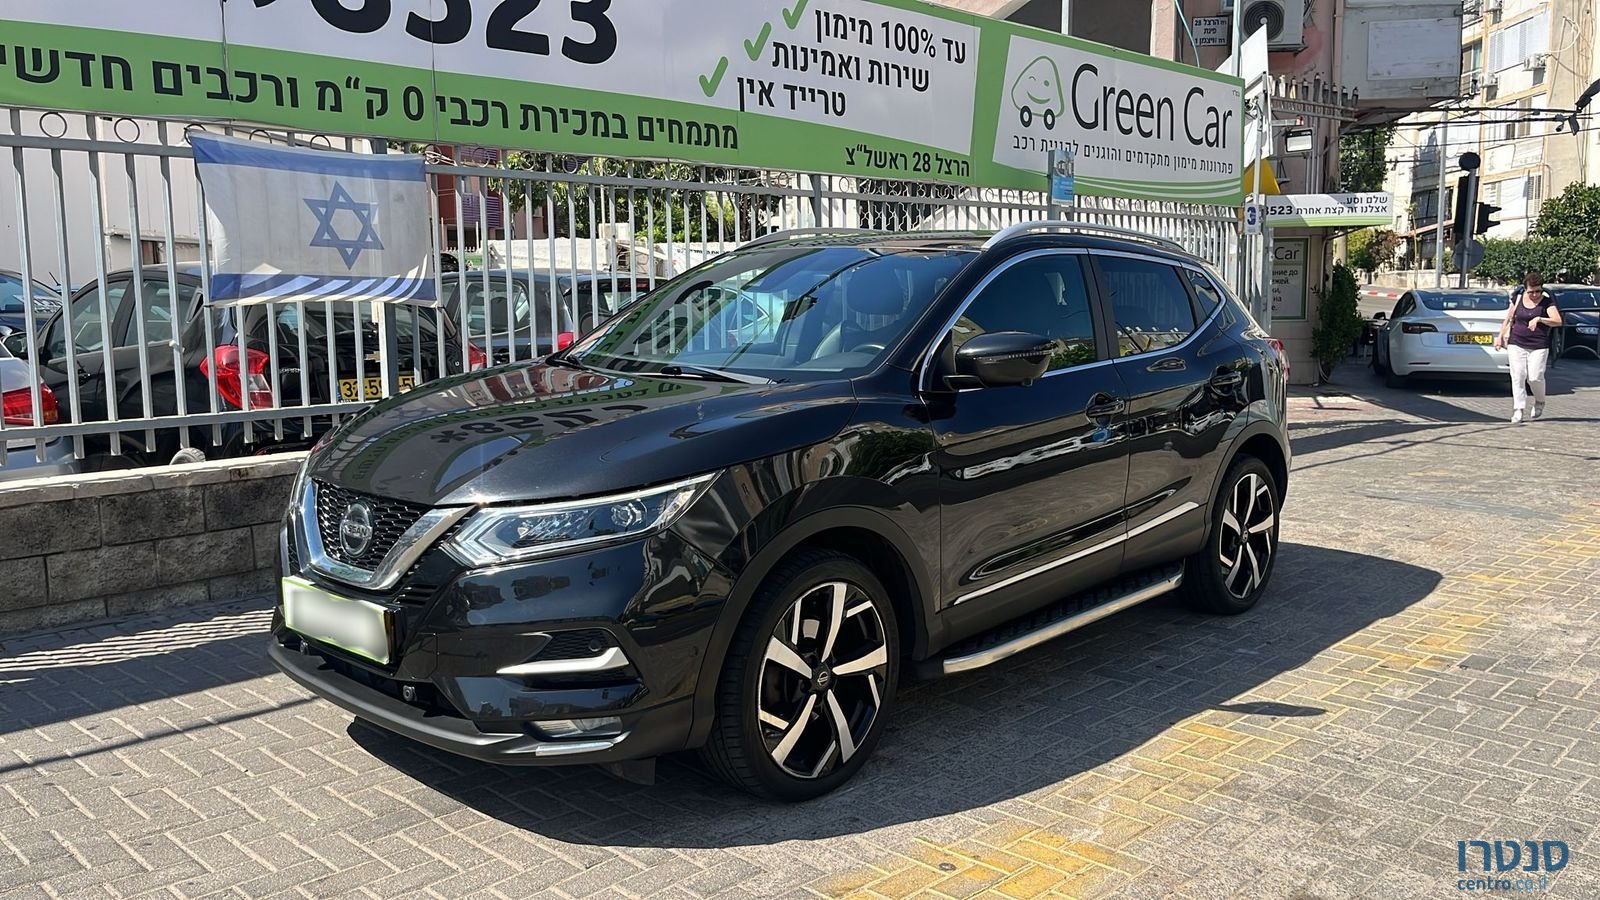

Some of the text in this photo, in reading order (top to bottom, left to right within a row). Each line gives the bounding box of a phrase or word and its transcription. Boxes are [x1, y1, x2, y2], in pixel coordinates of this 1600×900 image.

[815, 9, 966, 64] עד 100% מימון
[772, 41, 929, 92] שירות ואמינות
[152, 60, 299, 108] ורכבים
[403, 86, 424, 121] 0
[737, 77, 846, 117] טרייד אין
[1071, 63, 1233, 149] Green Car
[435, 95, 509, 129] רכבי
[520, 103, 628, 140] במכירת
[637, 115, 739, 150] מתמחים
[1013, 135, 1035, 151] רכב
[845, 143, 970, 177] הרצל 28 ראשל"צ
[1084, 144, 1121, 161] והוגנים
[1126, 150, 1170, 168] מתקדמים
[1173, 156, 1197, 171] מימון
[1200, 159, 1233, 175] פתרונות
[1360, 204, 1387, 213] אצלנו
[1366, 195, 1388, 204] שלם
[1296, 207, 1321, 215] אחרת
[1324, 206, 1344, 215] קצת
[1347, 206, 1358, 214] זה
[1274, 246, 1300, 260] Car
